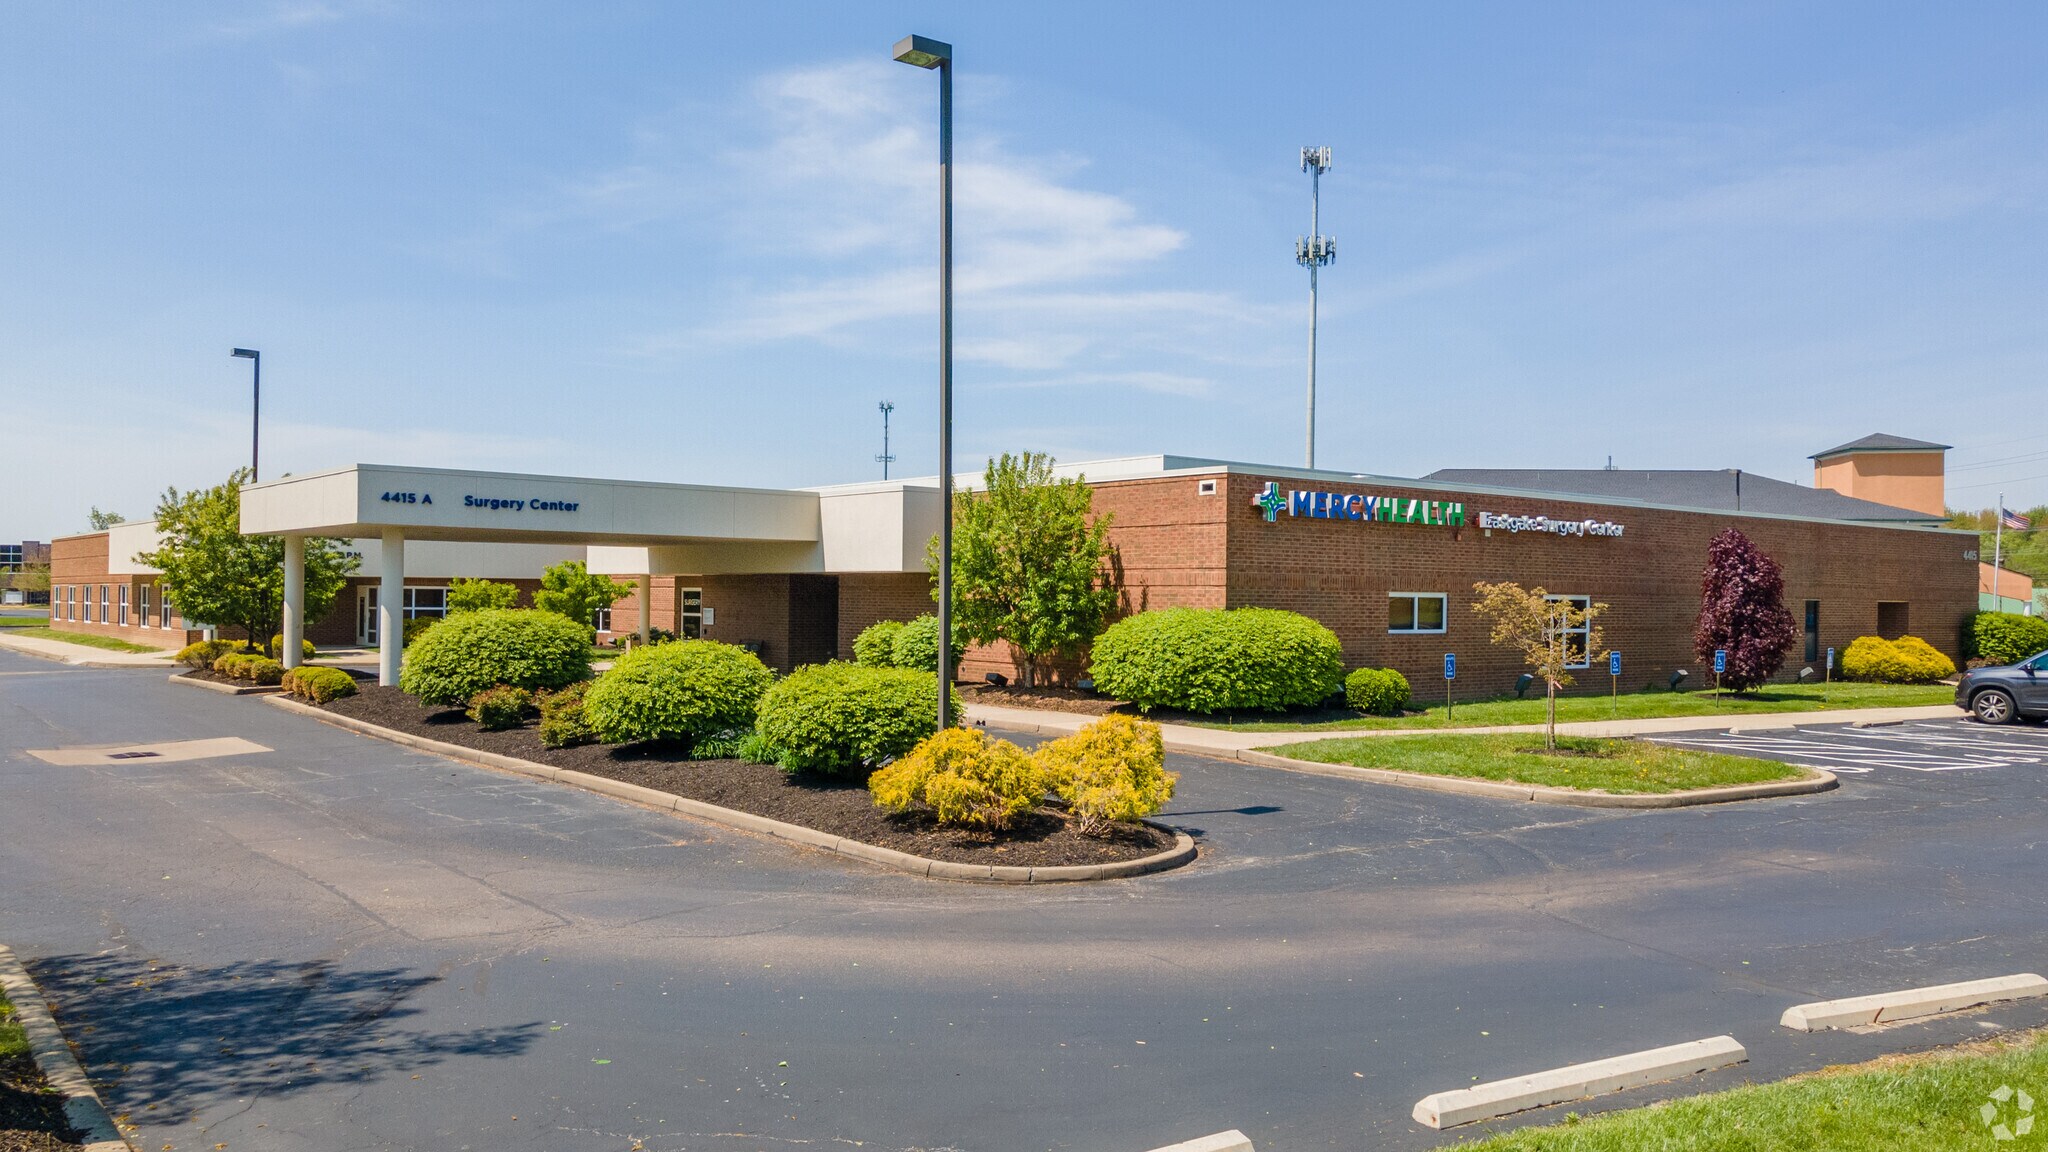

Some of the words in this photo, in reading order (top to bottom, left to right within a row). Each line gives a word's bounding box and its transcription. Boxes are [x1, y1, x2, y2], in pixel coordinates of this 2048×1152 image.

[381, 491, 416, 505] 4415
[421, 494, 433, 505] A
[464, 494, 525, 512] Surgery
[530, 498, 580, 512] Center
[1479, 511, 1538, 533] Eastgate
[1537, 516, 1585, 537] Surgery
[1585, 519, 1625, 537] Center
